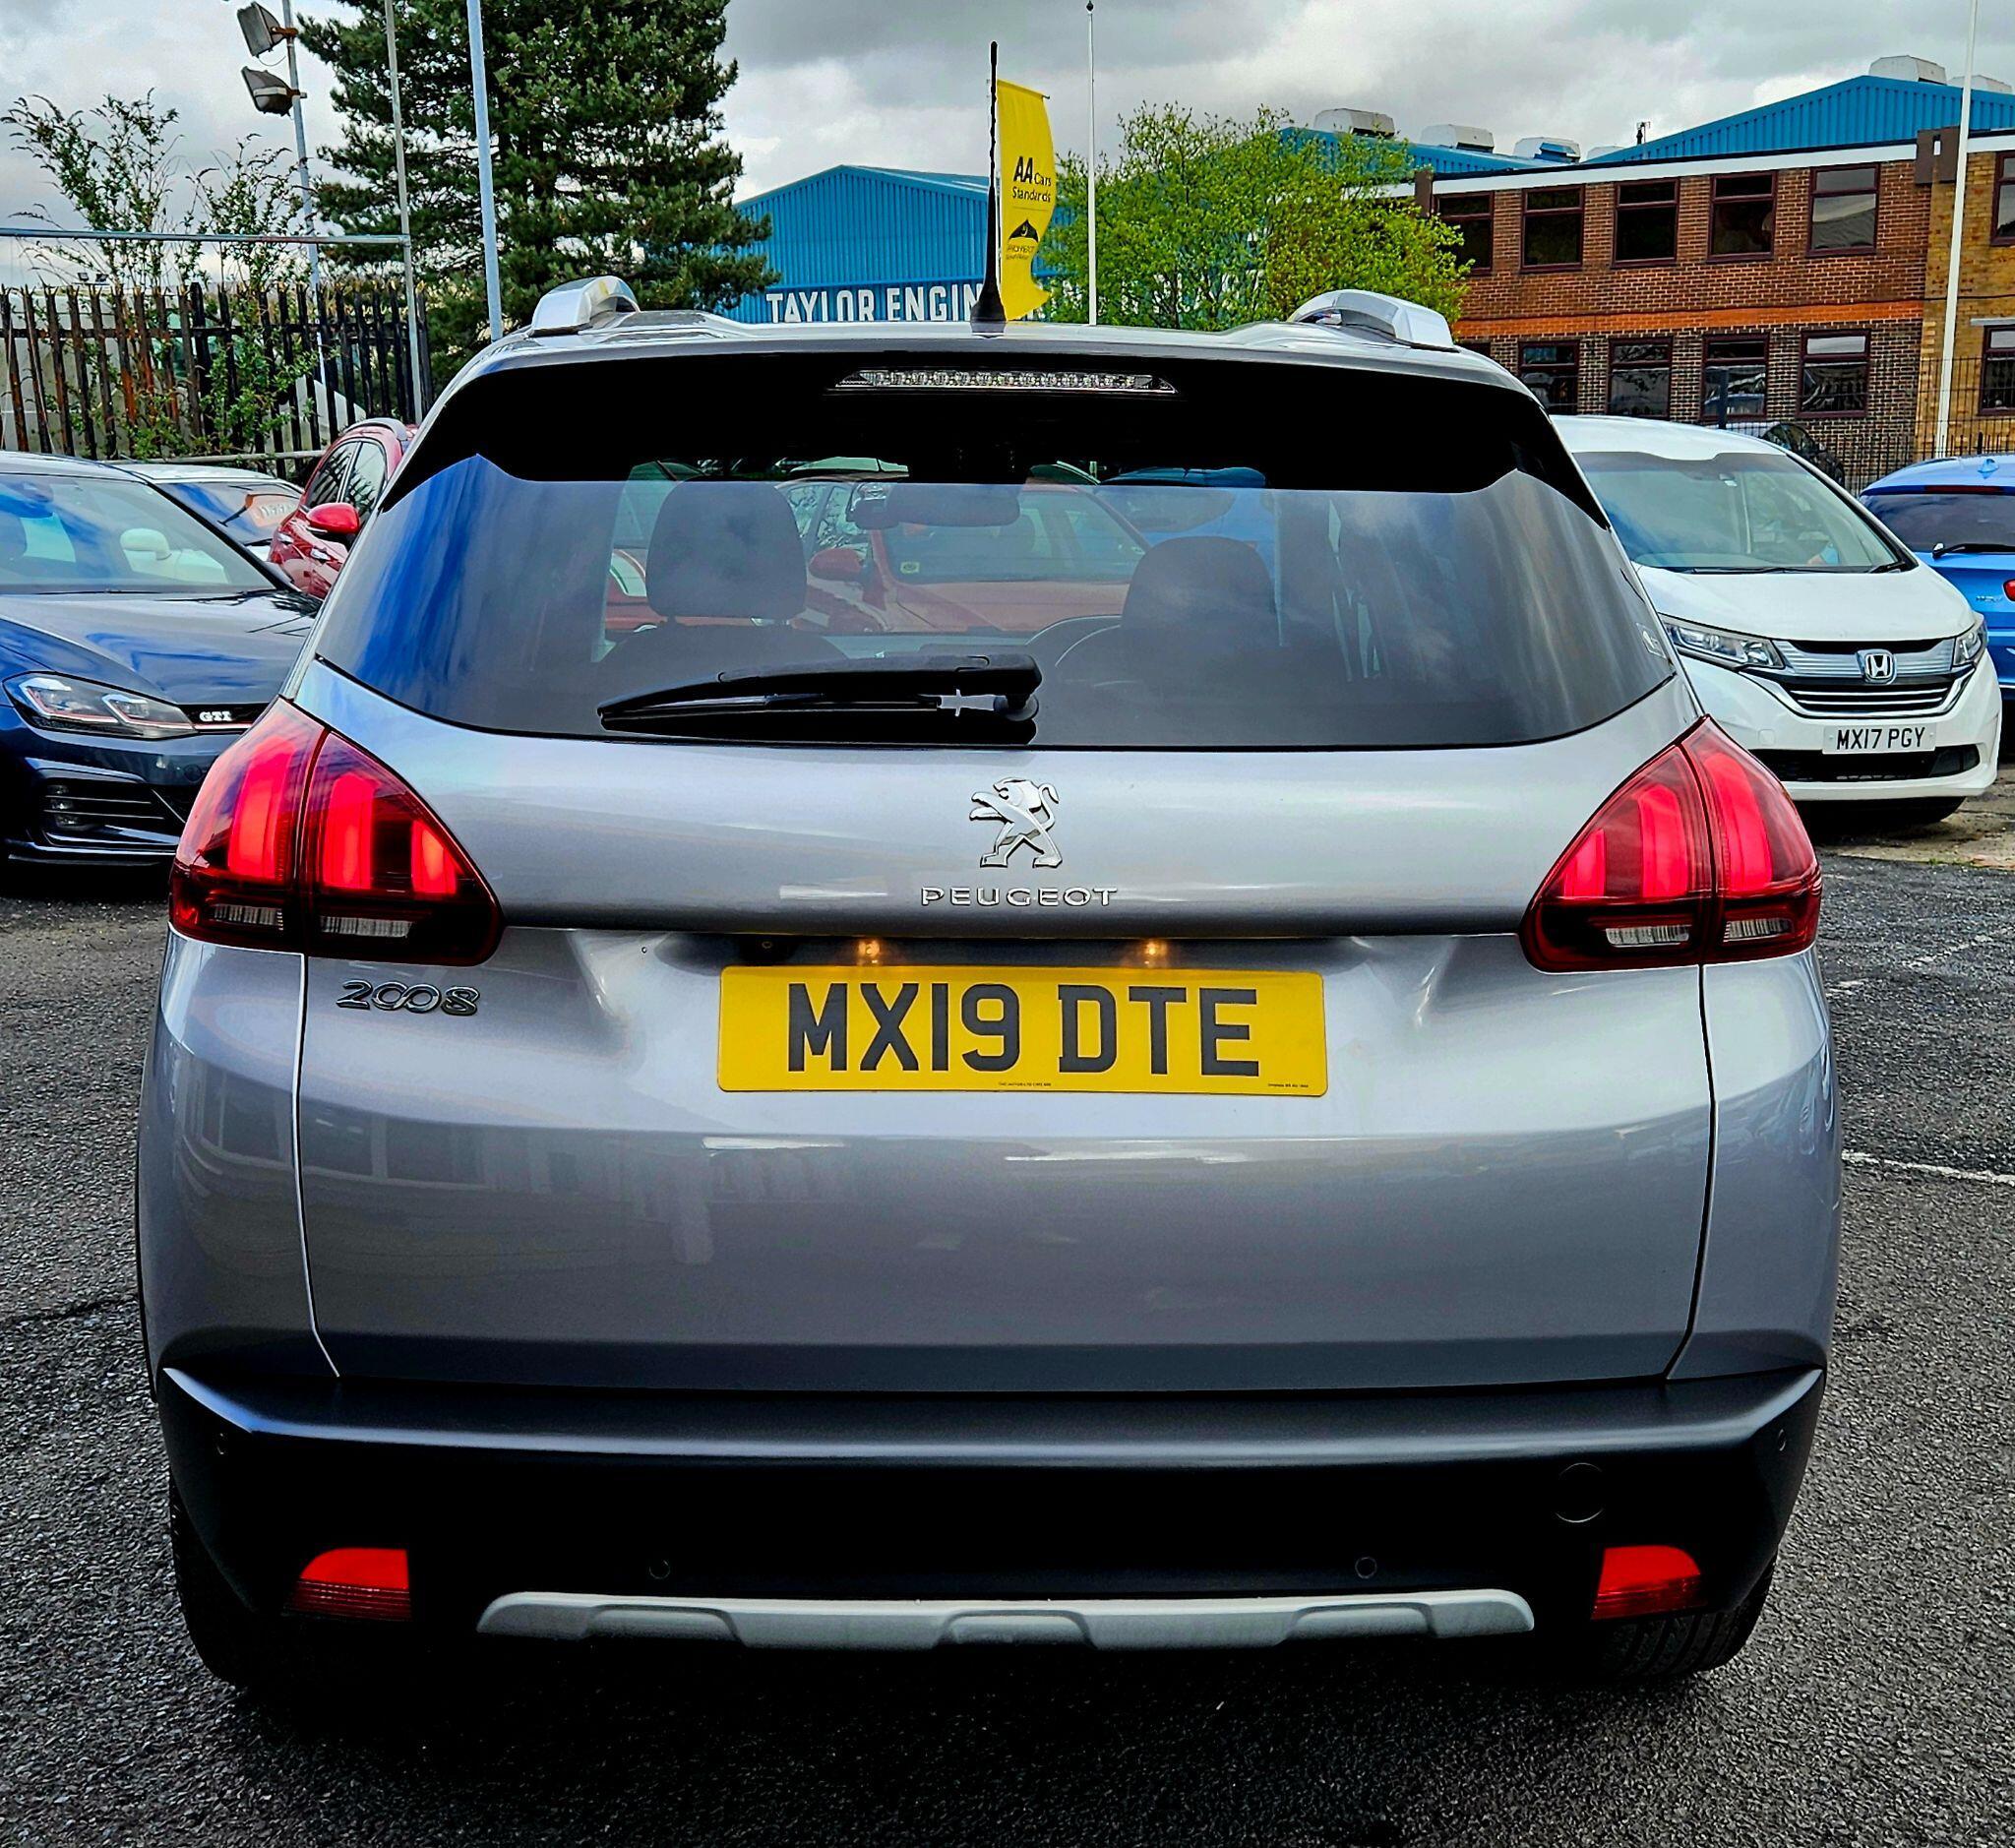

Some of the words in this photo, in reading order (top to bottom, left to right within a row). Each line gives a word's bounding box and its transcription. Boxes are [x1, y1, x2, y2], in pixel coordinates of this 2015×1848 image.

[1012, 155, 1033, 184] AA
[1034, 172, 1052, 187] Cars
[1012, 186, 1051, 203] Standards
[766, 289, 875, 323] TAYLOR
[199, 710, 233, 722] GTI
[1837, 729, 1882, 750] MX17
[1888, 727, 1925, 749] PGY
[921, 887, 1118, 906] PEUGEOT
[336, 978, 480, 1016] 2008
[788, 983, 1020, 1073] MX19
[1058, 984, 1259, 1077] DTE
